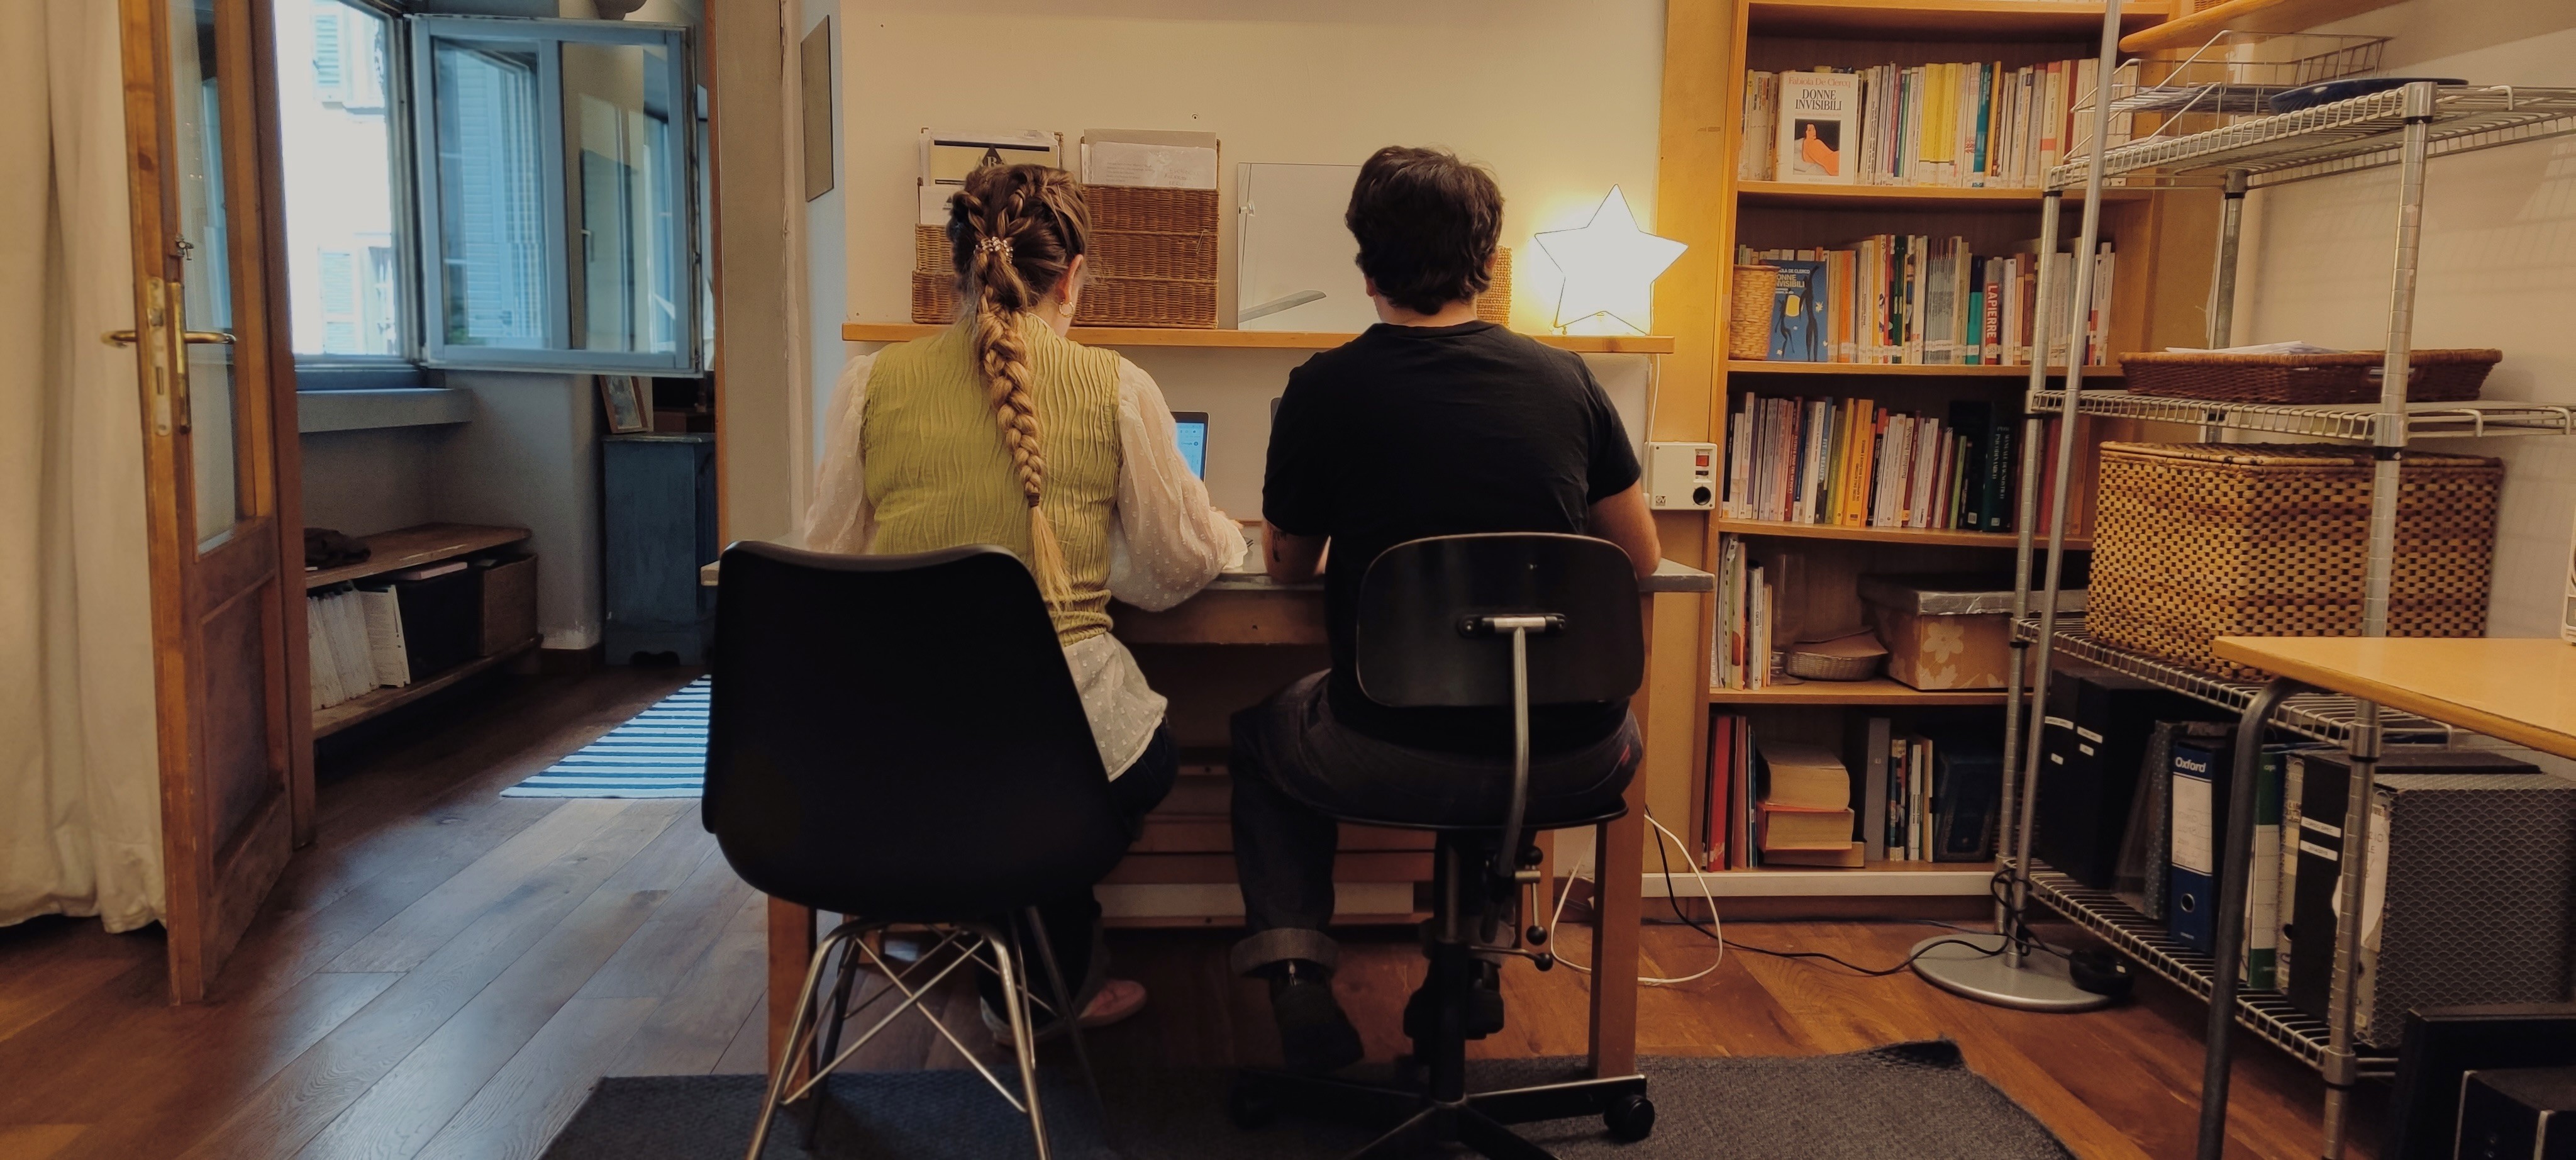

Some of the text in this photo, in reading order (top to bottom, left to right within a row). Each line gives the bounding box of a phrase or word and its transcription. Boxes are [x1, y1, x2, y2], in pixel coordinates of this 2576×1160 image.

[1789, 77, 1851, 88] Fabiola De Clercq
[1802, 89, 1836, 99] DONNE
[1796, 99, 1842, 111] INVISIBILI
[1987, 285, 1998, 338] LAPIERRE
[2175, 756, 2206, 773] Oxford
